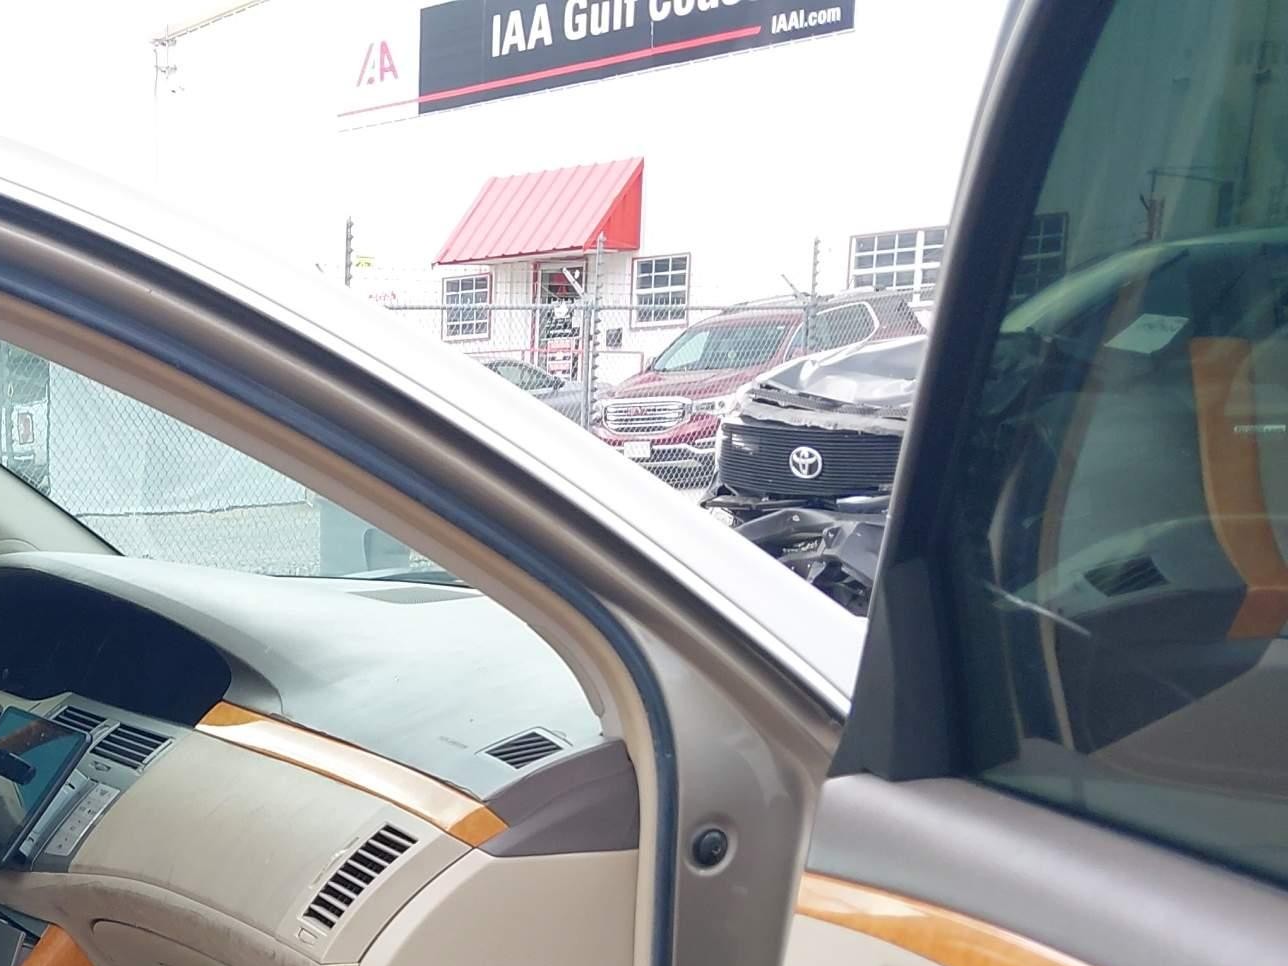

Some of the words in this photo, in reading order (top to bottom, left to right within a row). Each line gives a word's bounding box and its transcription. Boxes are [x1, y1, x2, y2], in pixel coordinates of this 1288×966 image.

[491, 3, 553, 58] IAA
[563, 0, 639, 41] Gulf
[770, 6, 842, 35] IAAI.com
